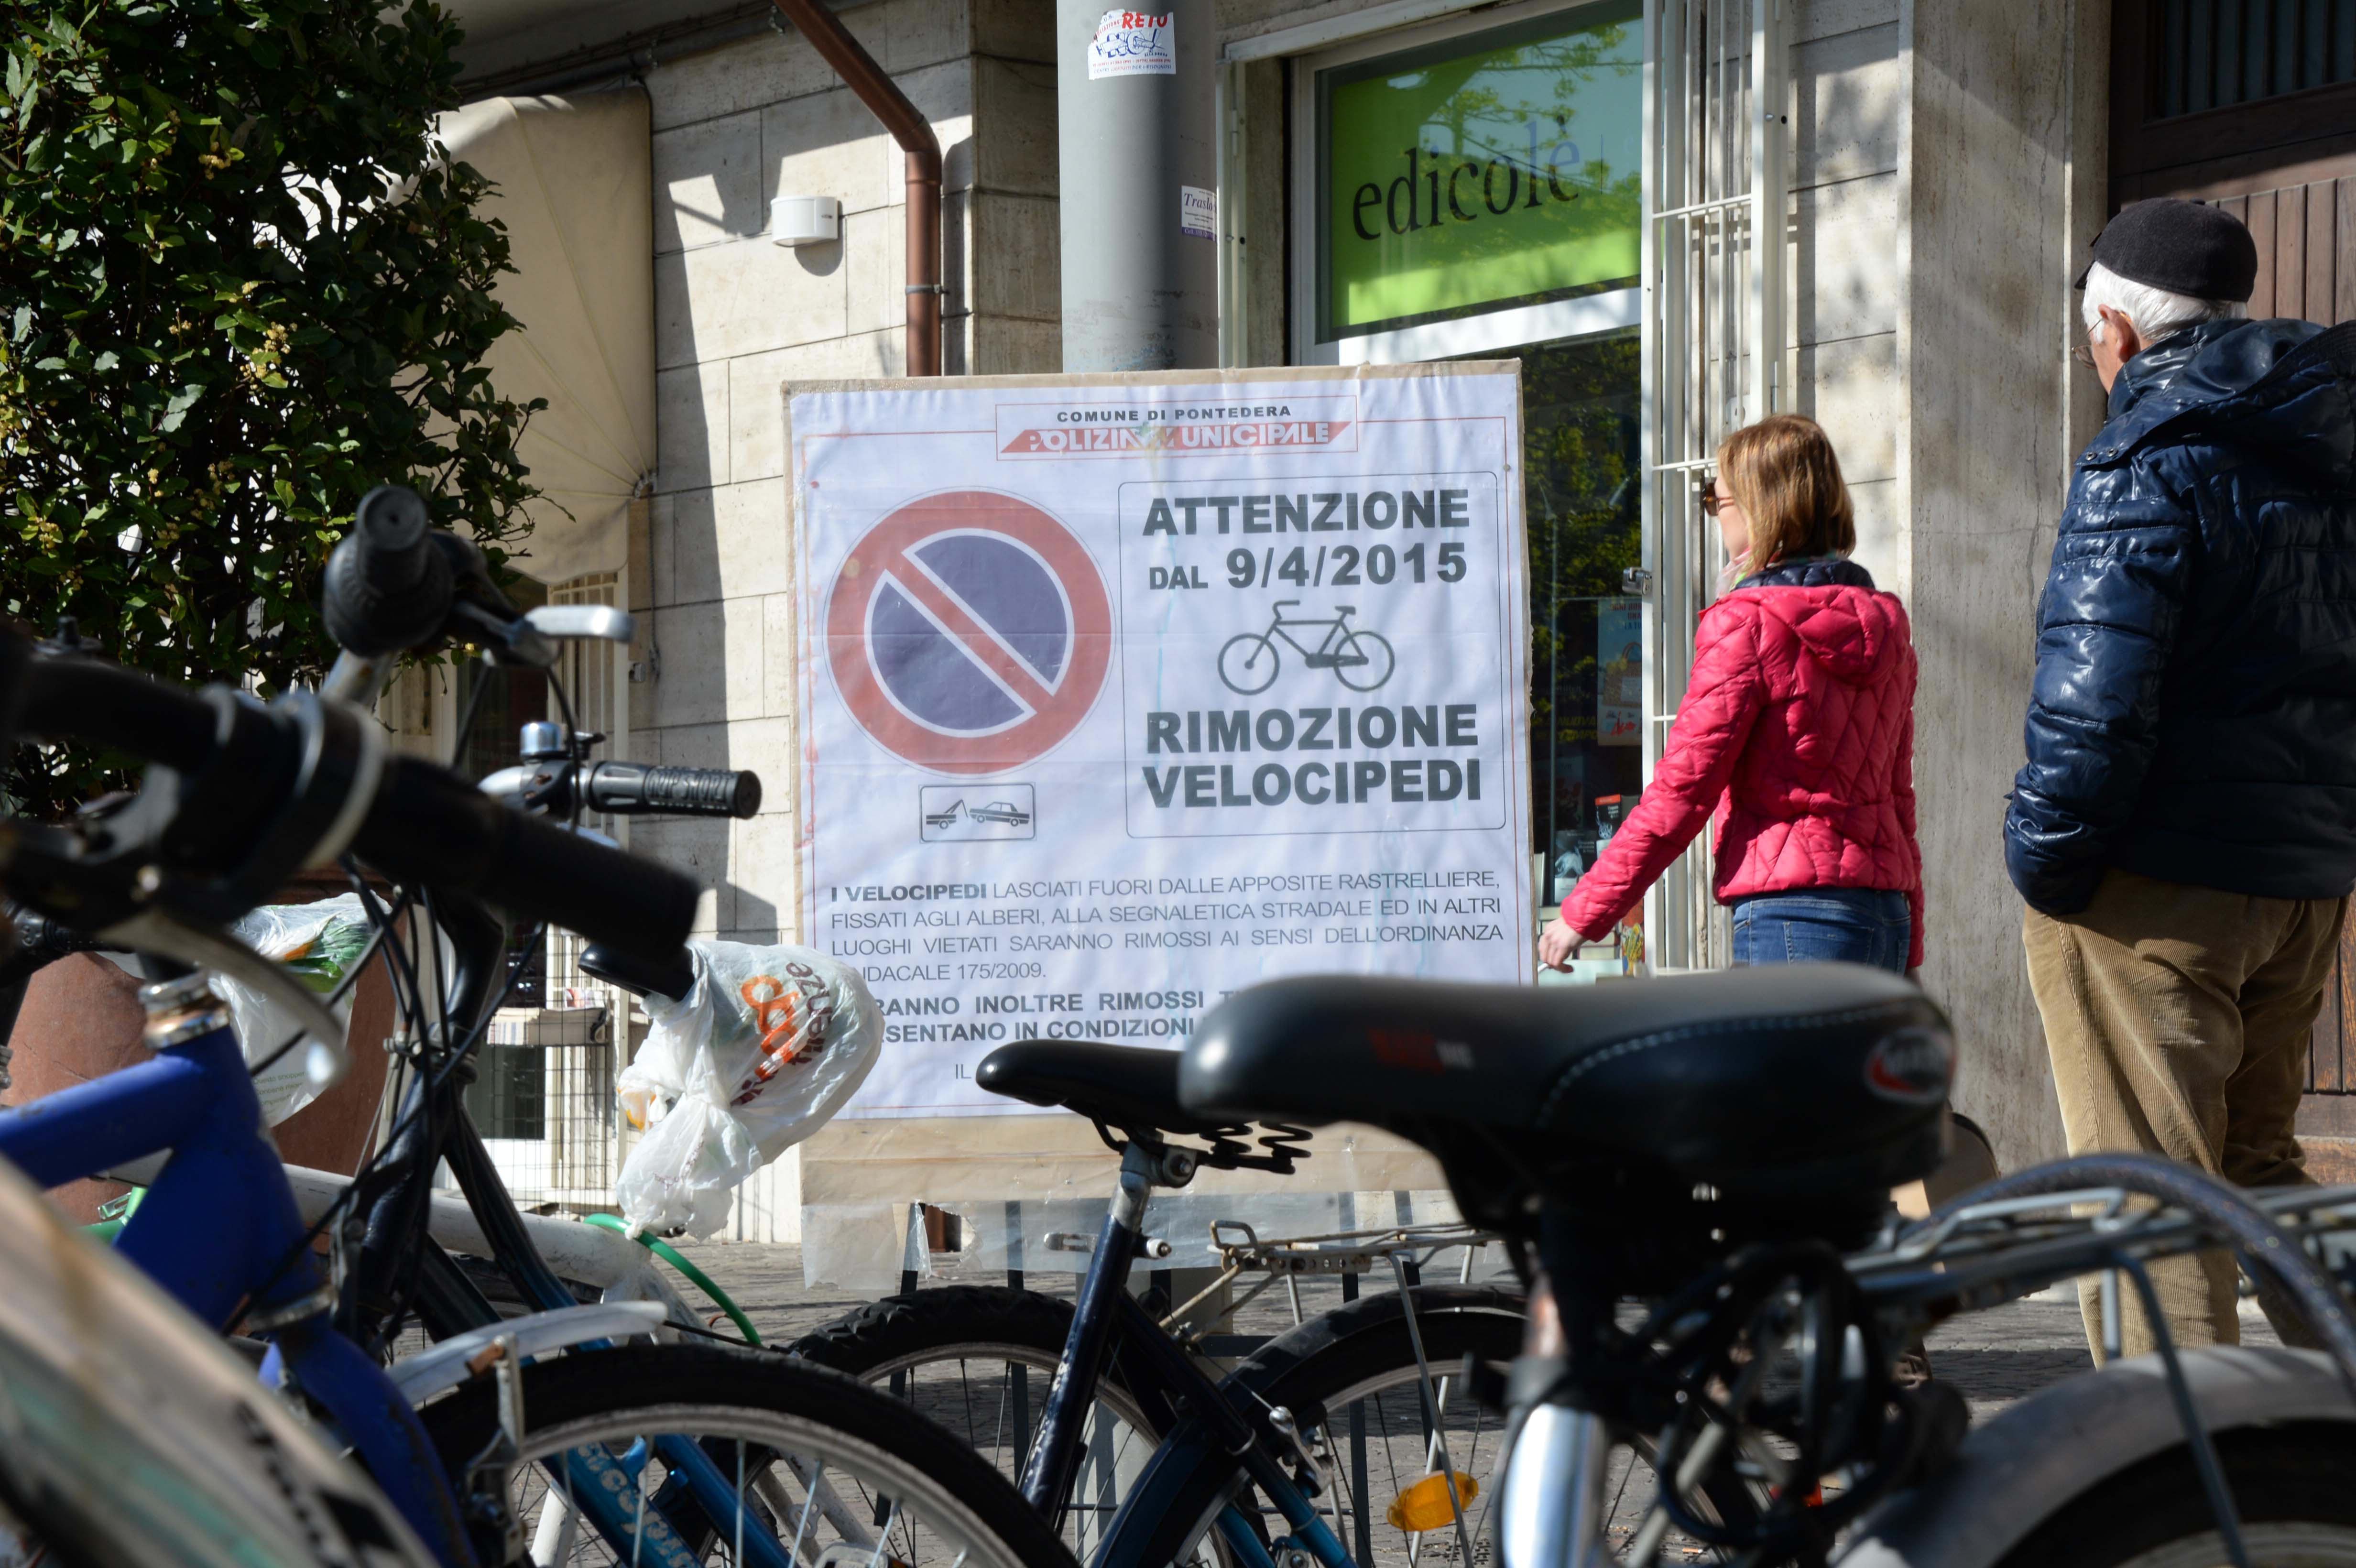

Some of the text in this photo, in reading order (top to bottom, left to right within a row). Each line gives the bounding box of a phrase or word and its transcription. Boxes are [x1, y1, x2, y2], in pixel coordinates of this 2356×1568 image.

[1057, 406, 1291, 422] COMUNE DI PONTEDERA
[1143, 489, 1469, 536] ATTENZIONE
[1150, 542, 1466, 589] DAL 9/4/2015
[1147, 704, 1478, 753] RIMOZIONE
[1142, 759, 1480, 808] VELOCIPEDI
[831, 871, 1499, 902] I VELOCIPEDI LASCIATI FUORI DALLE APPOSITE RASTRELLIERE,
[832, 898, 1500, 929] FISSATI AGLI ALBERI, ALLA SEGNALETICA STRADALE ED IN ALTRI
[832, 925, 1503, 956] LUOGHI VIETATI SARANNO RIMOSSI AI SENSI DELL'ORDINANZA
[863, 962, 1046, 981] DACALE 175/2009.
[976, 994, 1083, 1013] INOLTRE
[1099, 991, 1203, 1011] RIMOSSI
[886, 1017, 1194, 1043] SENTANO IN CONDIZIONI
